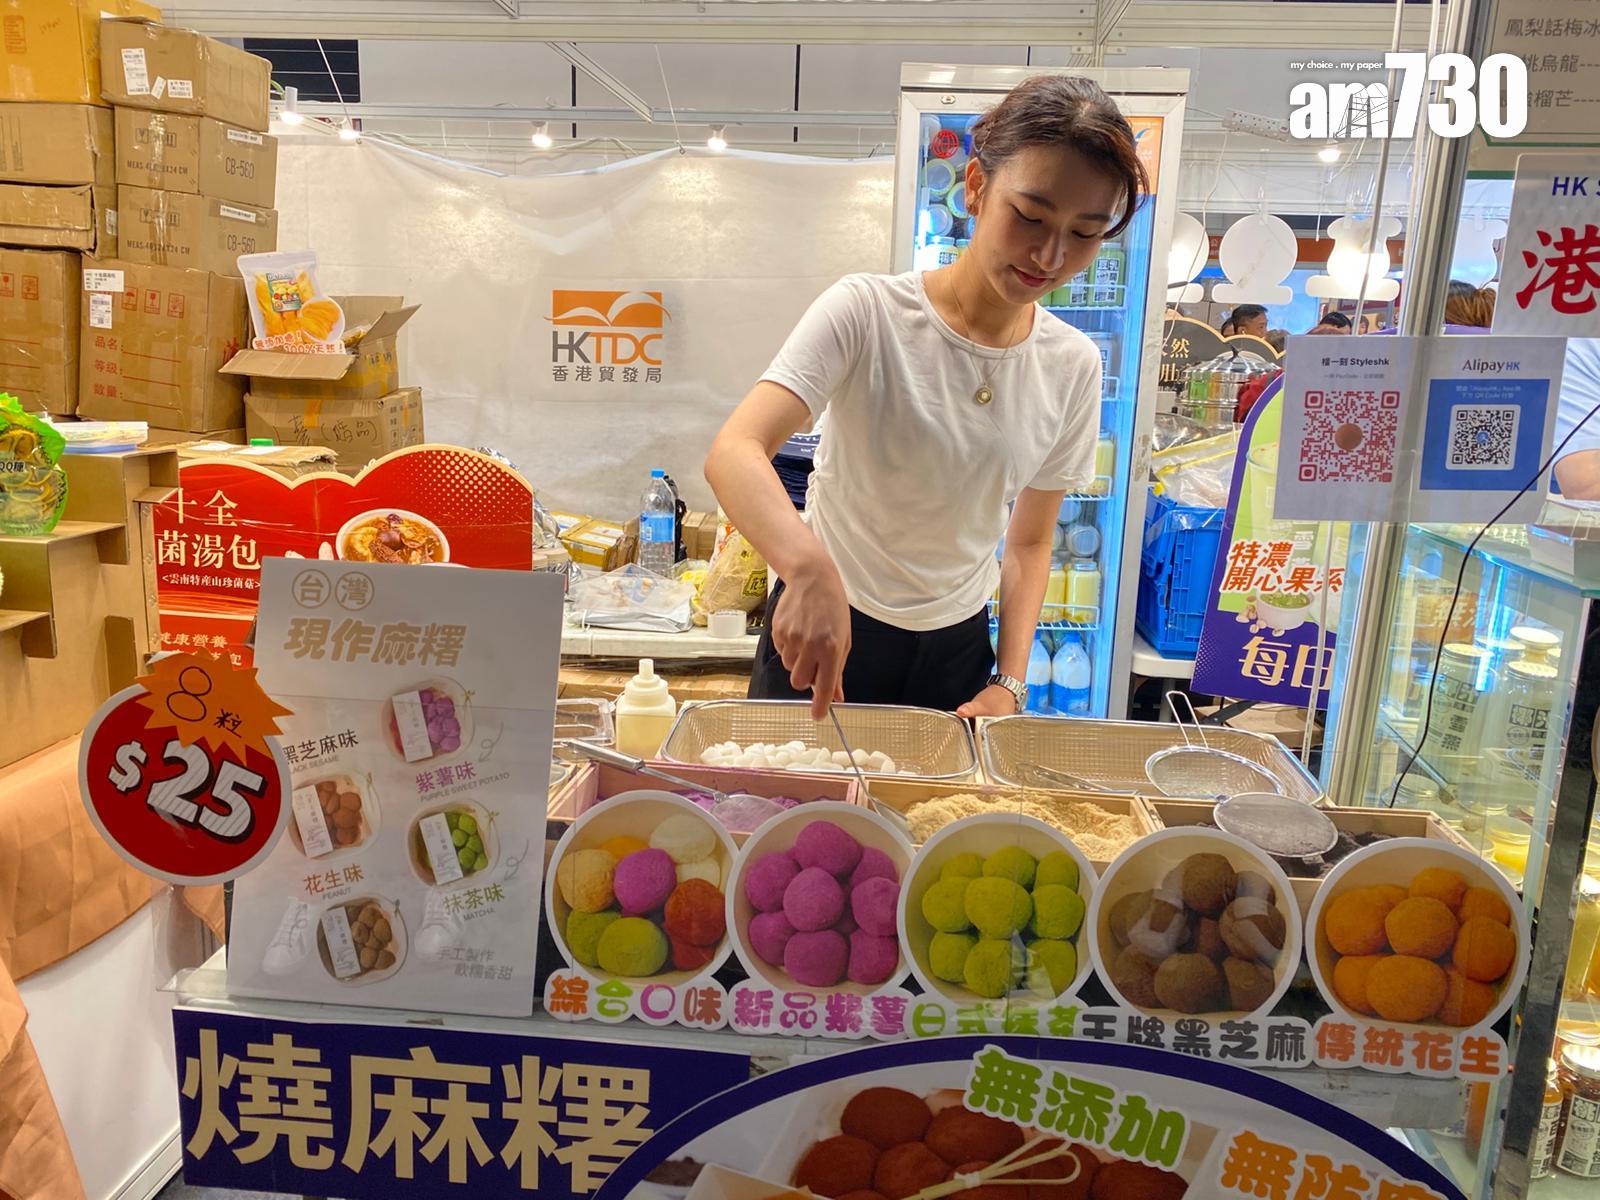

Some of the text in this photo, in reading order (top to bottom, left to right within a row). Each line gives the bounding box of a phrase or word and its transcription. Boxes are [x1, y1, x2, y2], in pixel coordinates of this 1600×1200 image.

[225, 156, 254, 179] CB-560
[1516, 224, 1600, 314] 港
[552, 331, 662, 365] HKTDC
[1350, 357, 1390, 367] Styleshk
[552, 365, 662, 384] 香港貿發局
[163, 487, 238, 527] 十全
[155, 530, 261, 570] 菌湯包
[1229, 540, 1294, 568] 特濃
[298, 574, 370, 606] 台灣
[284, 618, 467, 667] 現作麻糬
[282, 729, 359, 765] 黑芝麻味
[108, 739, 265, 840] $25
[415, 761, 476, 795] 紫薯味
[303, 863, 364, 896] 花生味
[443, 883, 505, 915] 抹茶味
[1314, 1022, 1501, 1076] 傳統花生
[181, 1027, 655, 1195] 燒麻糬
[970, 1050, 1186, 1167] 無添加
